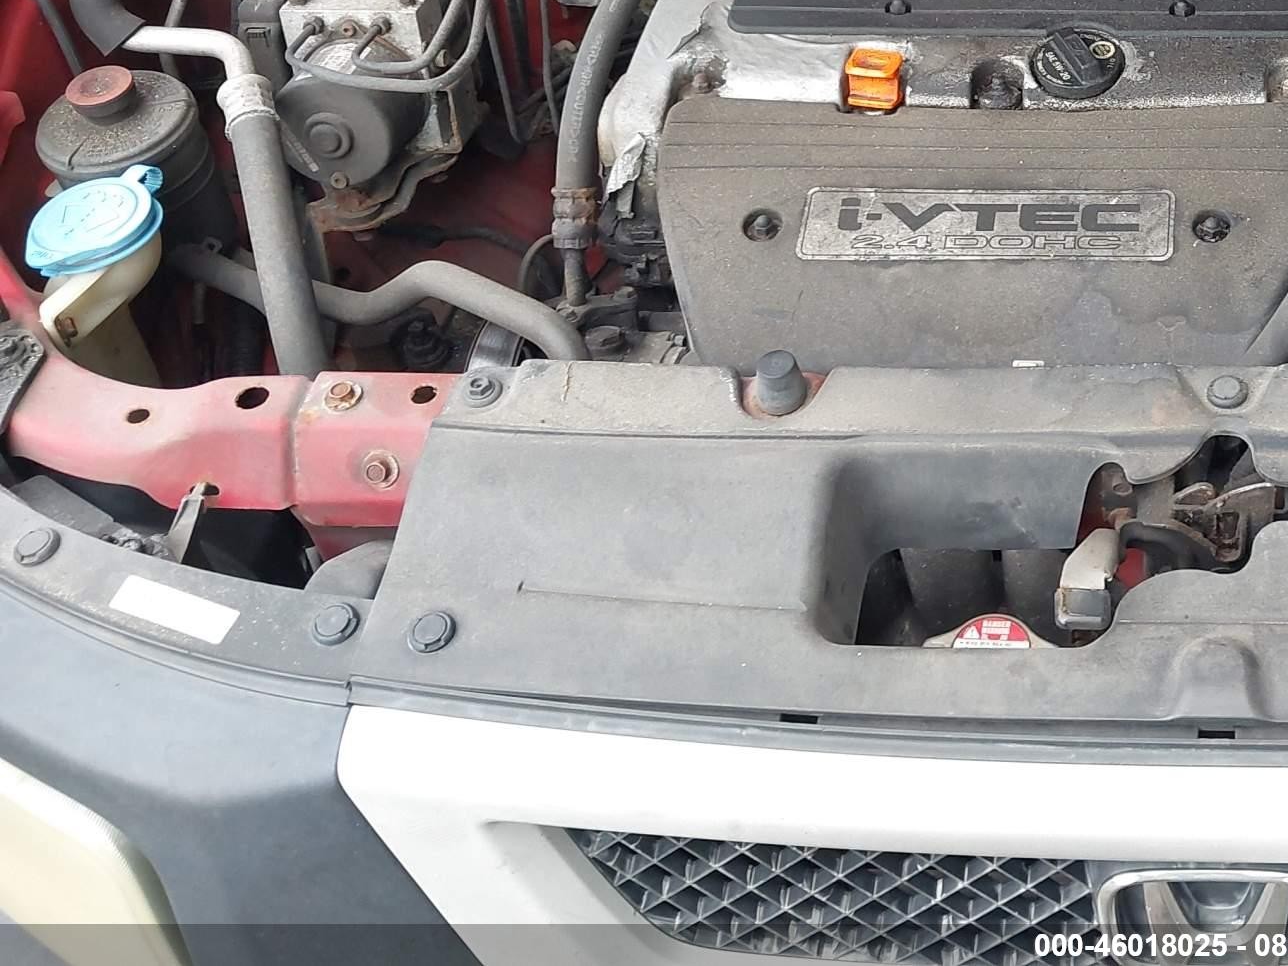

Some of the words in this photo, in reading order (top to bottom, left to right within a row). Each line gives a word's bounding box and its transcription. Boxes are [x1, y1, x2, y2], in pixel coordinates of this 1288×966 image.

[838, 197, 1141, 232] i-VTEC
[851, 234, 932, 250] 2.4
[943, 234, 1123, 250] DOHC
